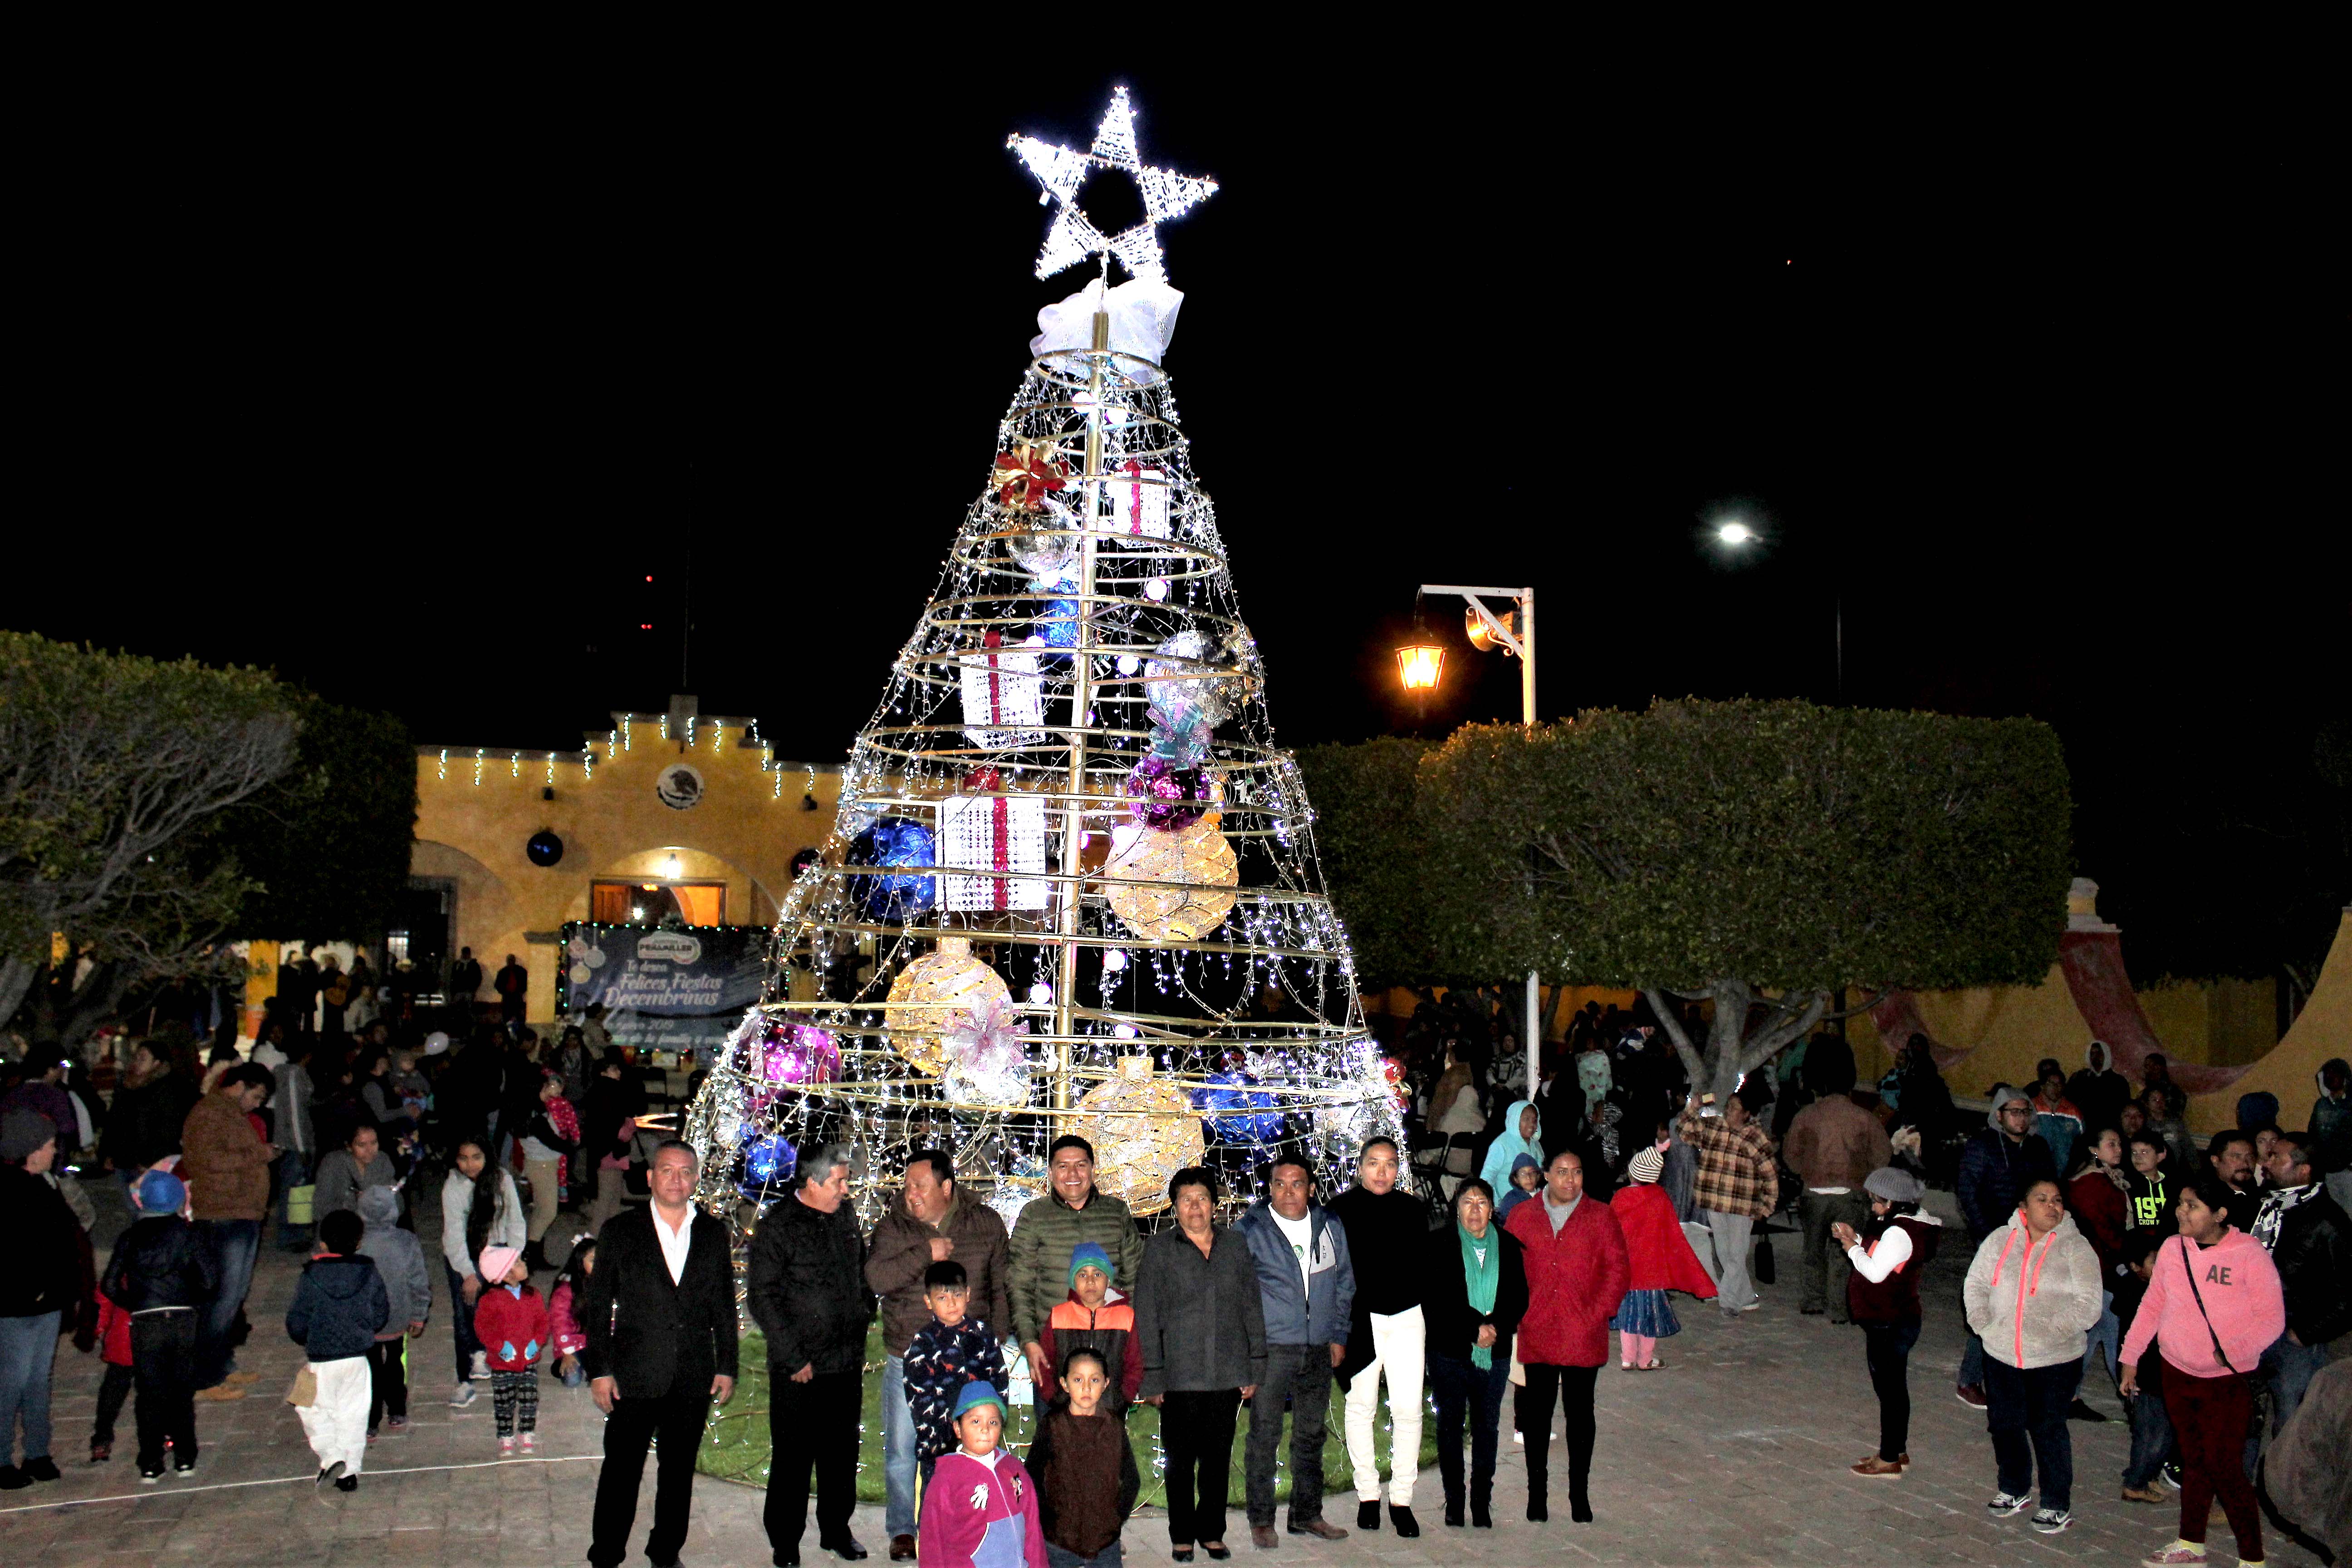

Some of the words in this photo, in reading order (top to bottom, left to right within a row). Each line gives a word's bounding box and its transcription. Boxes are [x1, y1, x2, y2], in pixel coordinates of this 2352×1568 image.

[627, 960, 638, 972] Te
[620, 973, 667, 990] Felices
[672, 972, 723, 990] Fiestas
[603, 986, 719, 1008] Decembrinas
[2206, 1265, 2232, 1285] AE
